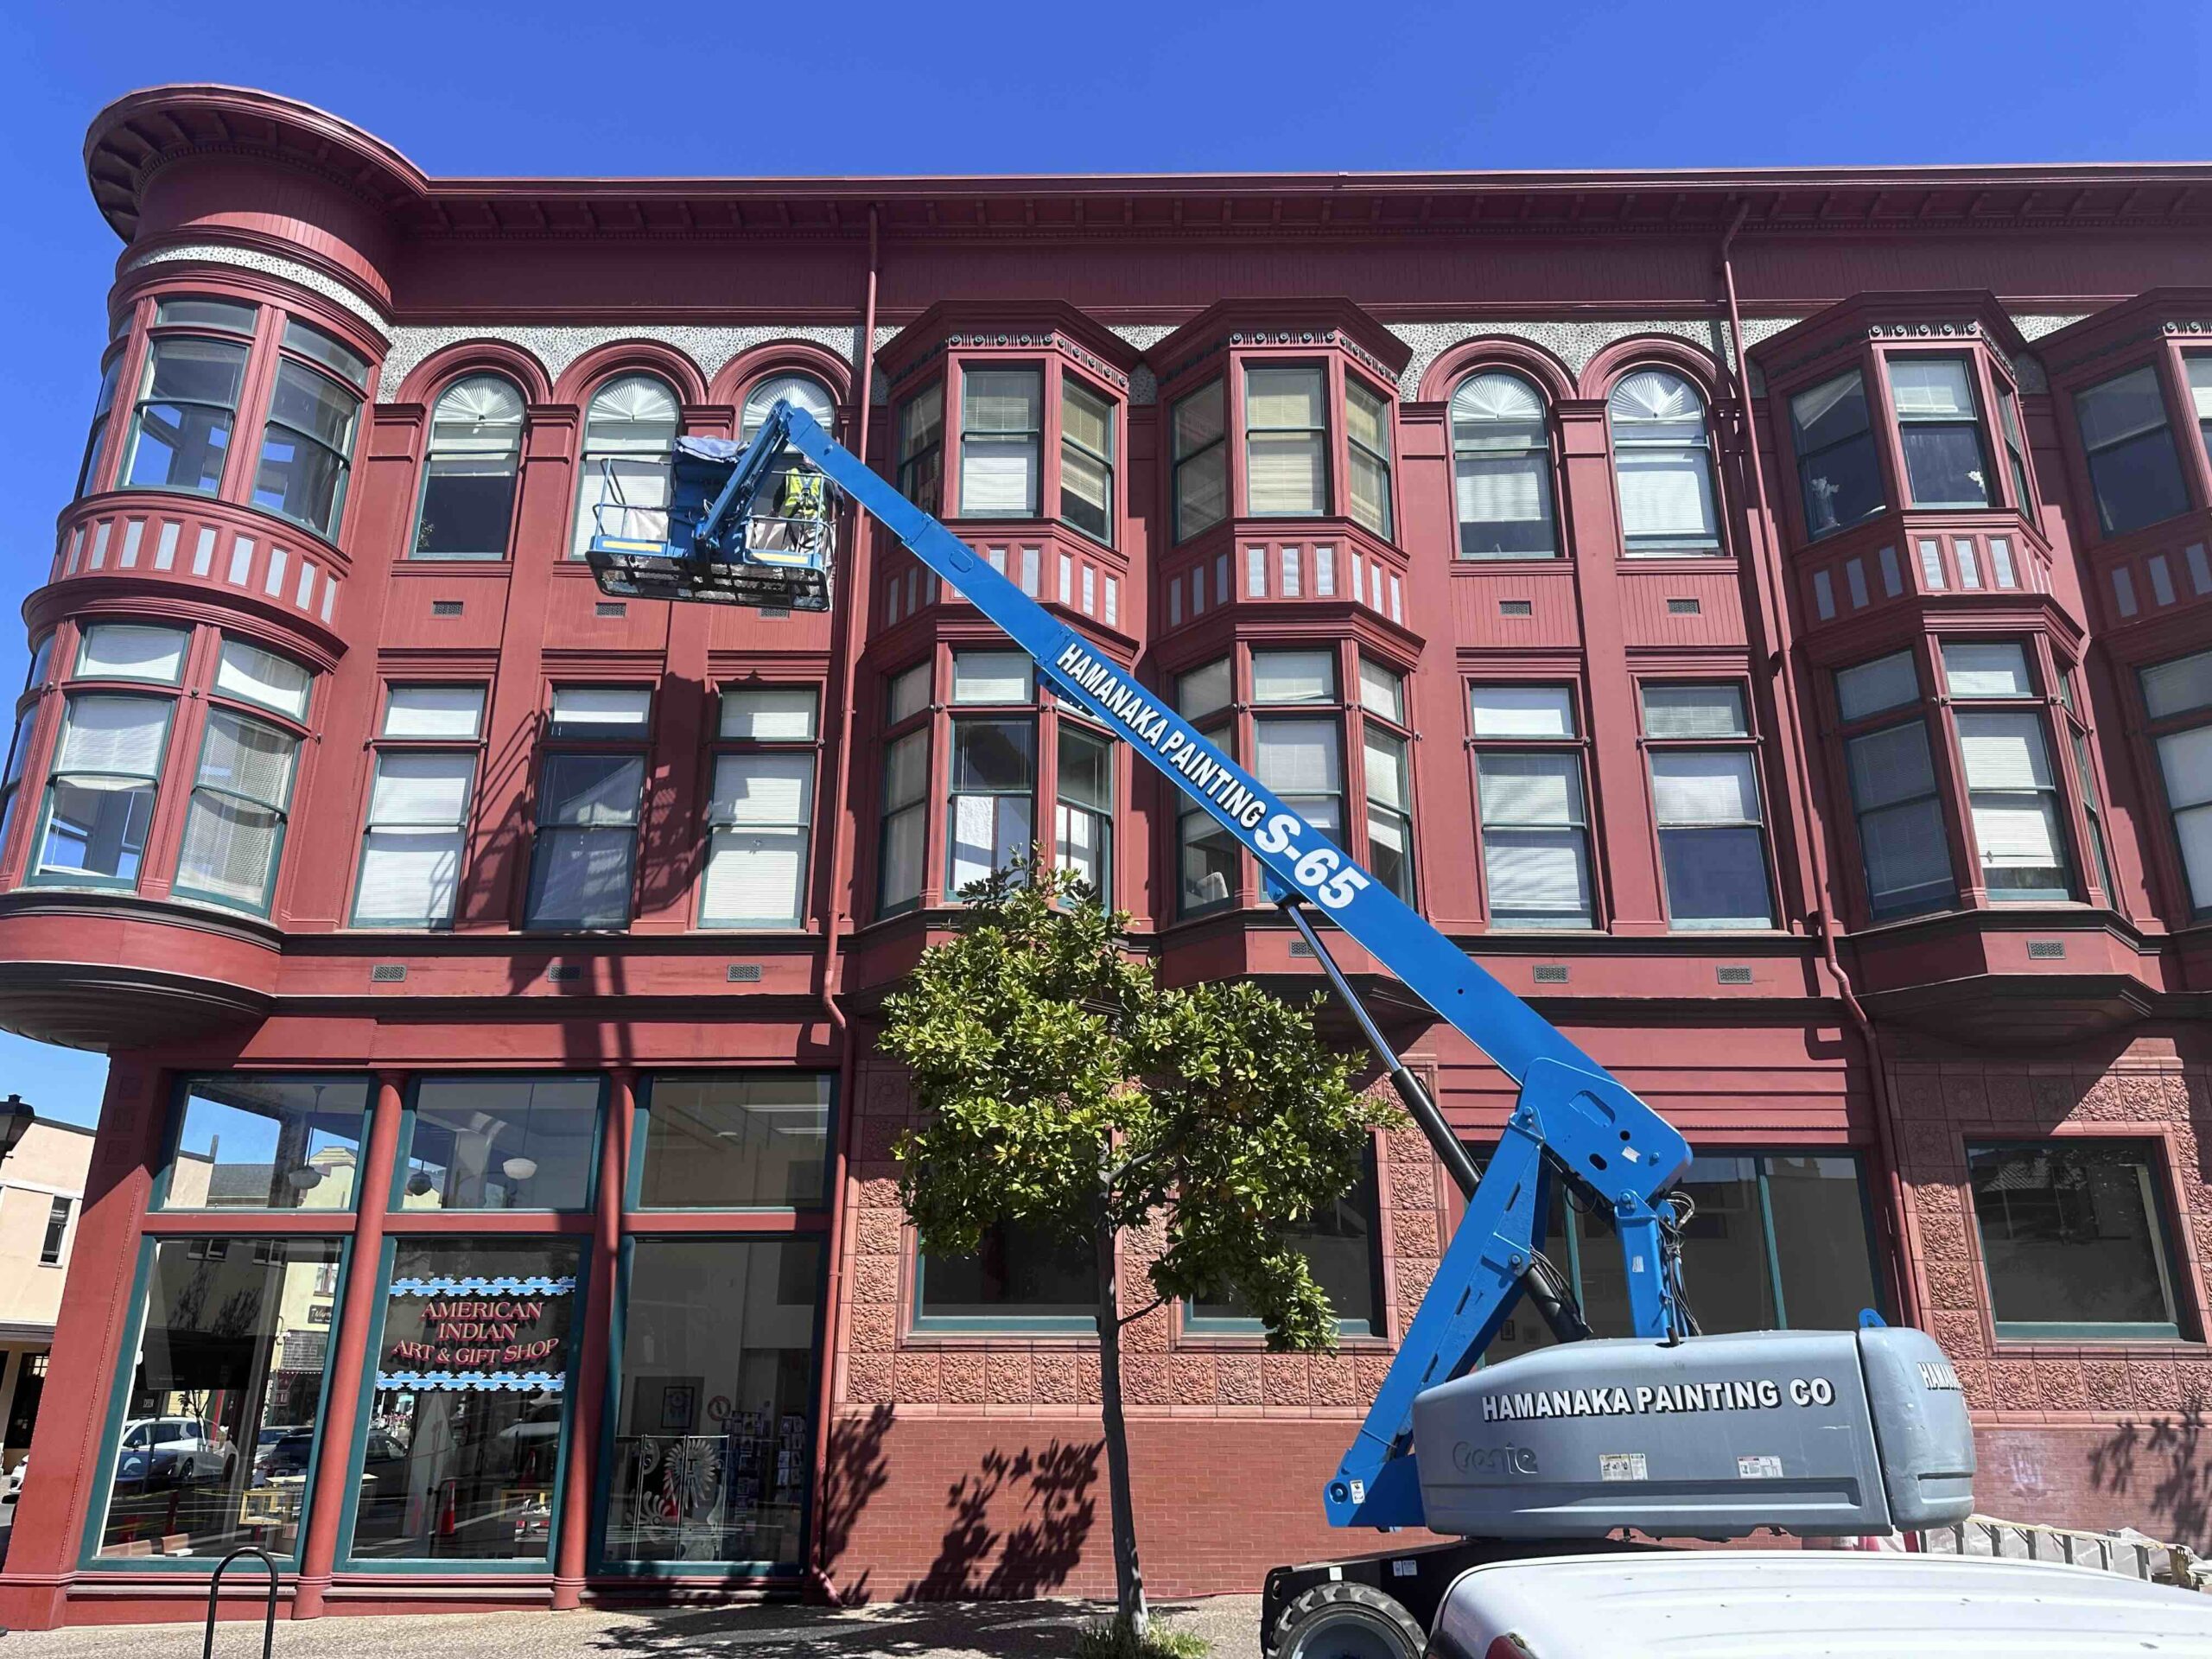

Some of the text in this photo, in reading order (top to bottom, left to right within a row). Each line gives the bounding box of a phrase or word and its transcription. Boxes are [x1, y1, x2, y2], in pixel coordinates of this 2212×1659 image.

[1056, 643, 1268, 830] HAMANAKA PAINTING
[1255, 814, 1370, 909] S-65
[421, 1301, 543, 1320] AMERICAN
[438, 1323, 519, 1342] INDIAN
[392, 1338, 560, 1365] ART & GIFT SHOP
[1482, 1377, 1835, 1422] HAMANAKA PAINTING CO
